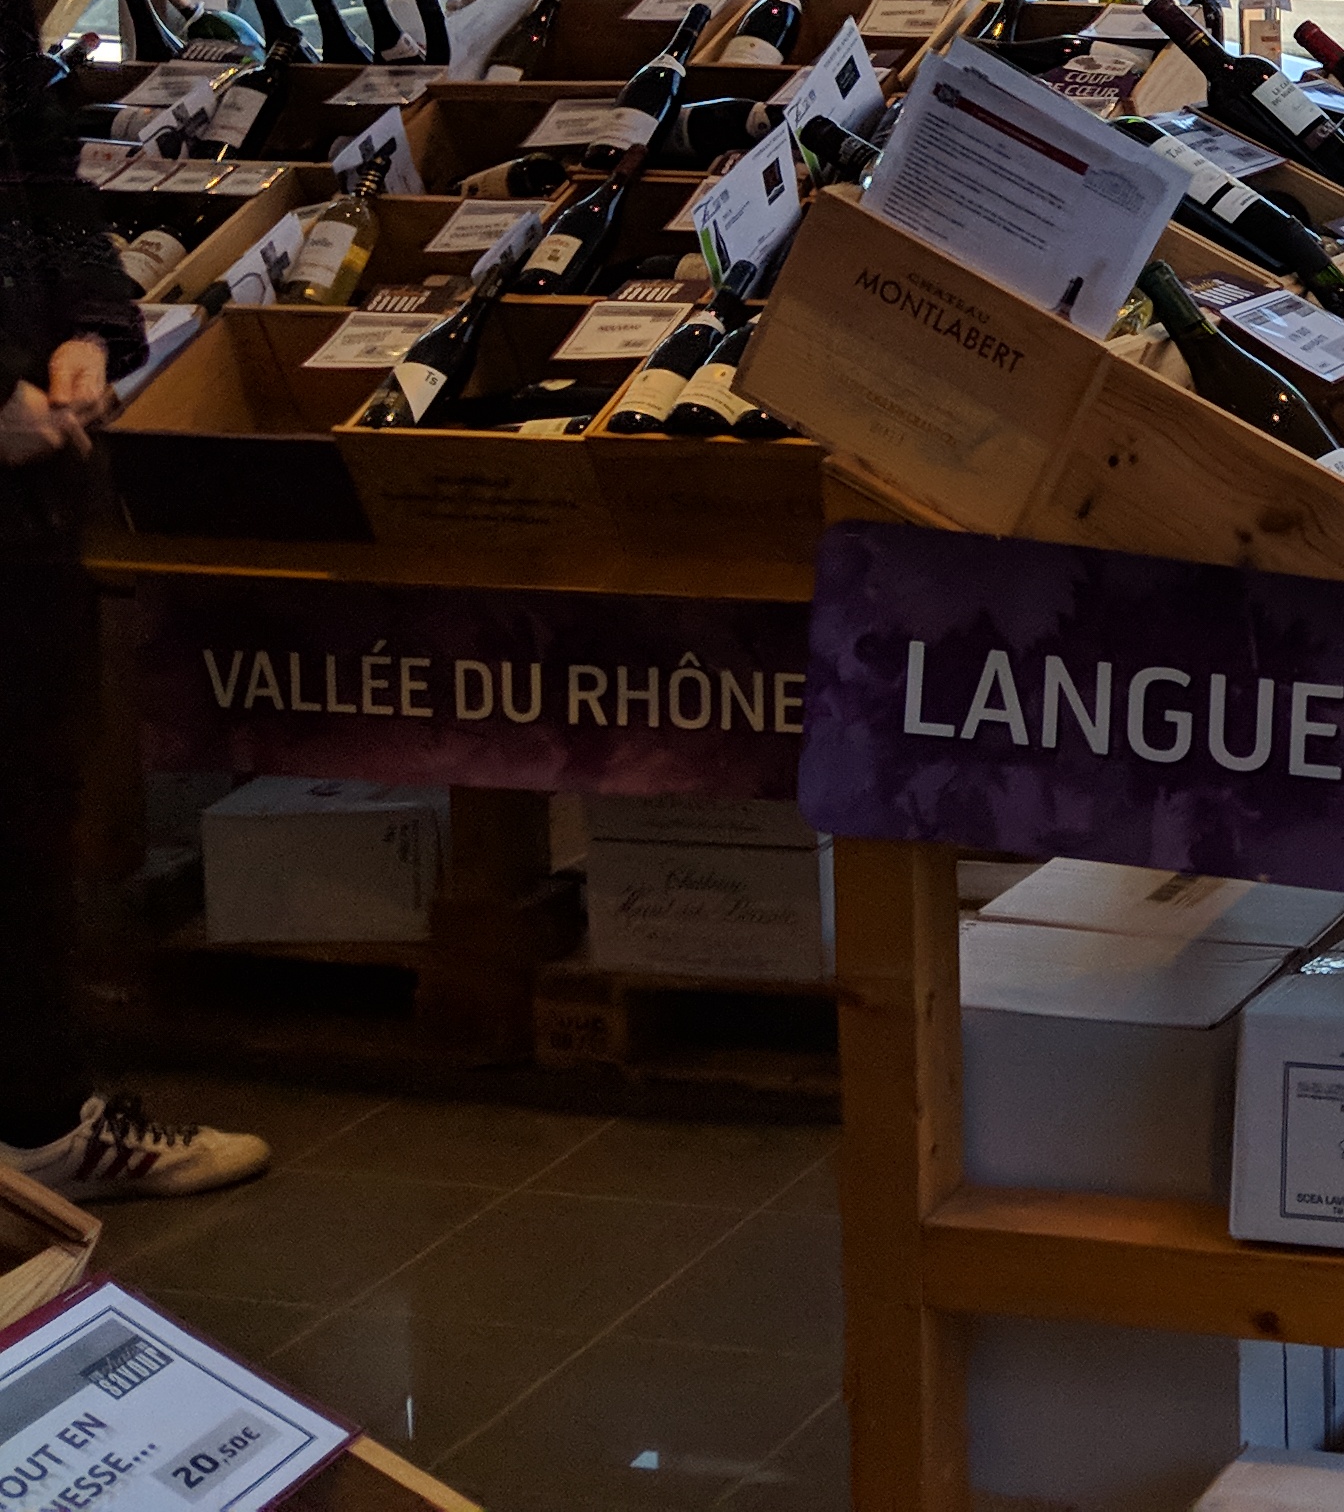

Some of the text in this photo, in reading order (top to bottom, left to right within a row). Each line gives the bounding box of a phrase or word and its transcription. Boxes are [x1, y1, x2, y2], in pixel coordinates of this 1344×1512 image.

[1063, 84, 1120, 99] CŒUR
[1064, 72, 1116, 85] COUP
[854, 266, 1026, 374] MONTLABERT
[424, 371, 439, 387] Ts
[202, 640, 806, 734] VALLÉE DU RHÔNE
[56, 1410, 109, 1450] EN
[171, 1425, 263, 1490] 20,50€
